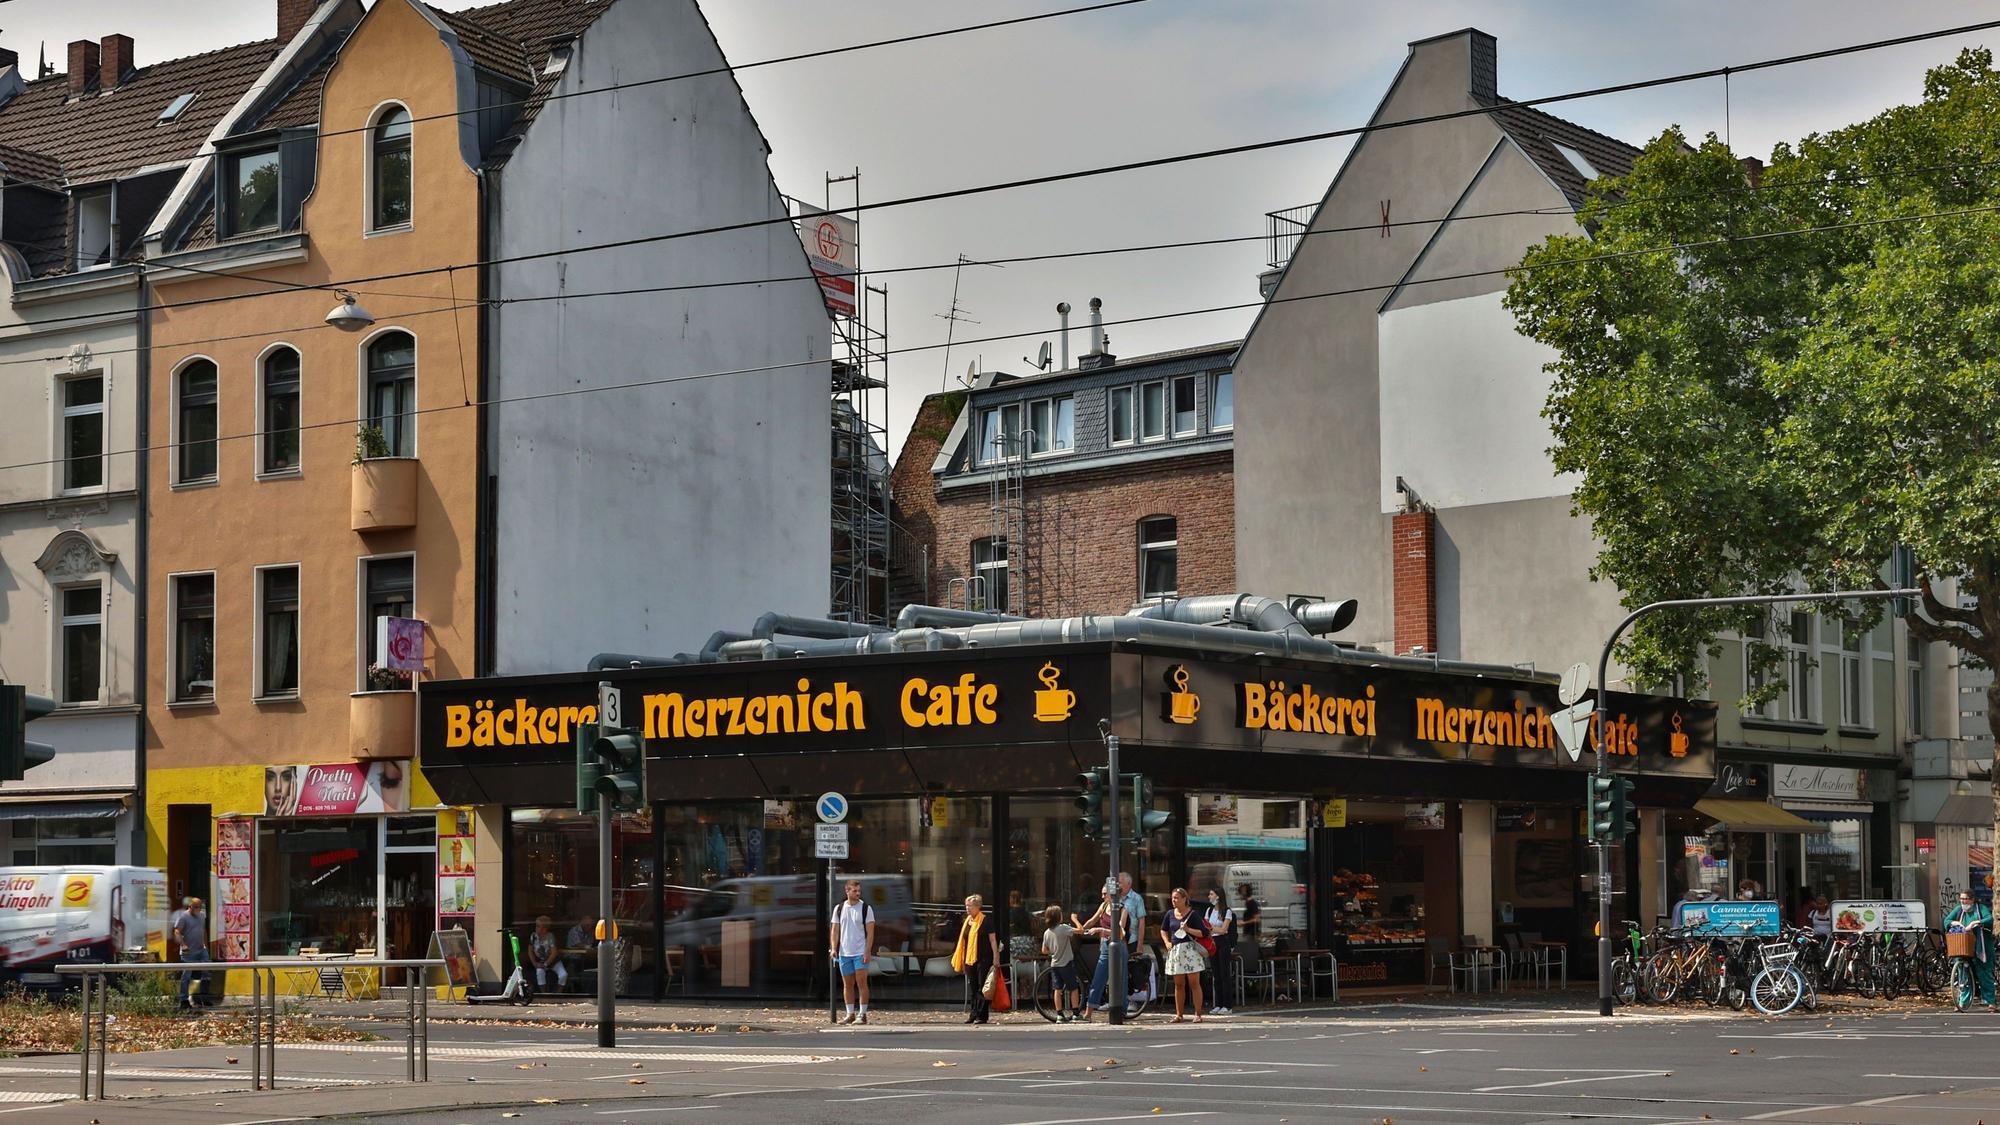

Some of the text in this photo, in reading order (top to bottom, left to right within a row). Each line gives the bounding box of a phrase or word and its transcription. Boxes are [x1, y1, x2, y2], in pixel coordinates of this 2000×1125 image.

[446, 673, 997, 747] Bäckere Merzenich Cafe
[608, 692, 618, 723] 3
[1245, 680, 1376, 737] Bäckerei
[1416, 698, 1554, 749] Merzenich
[308, 767, 353, 786] Pretty
[318, 785, 357, 802] Nails
[0, 892, 53, 911] Lingohr
[1711, 903, 1777, 914] Carmen Lucia
